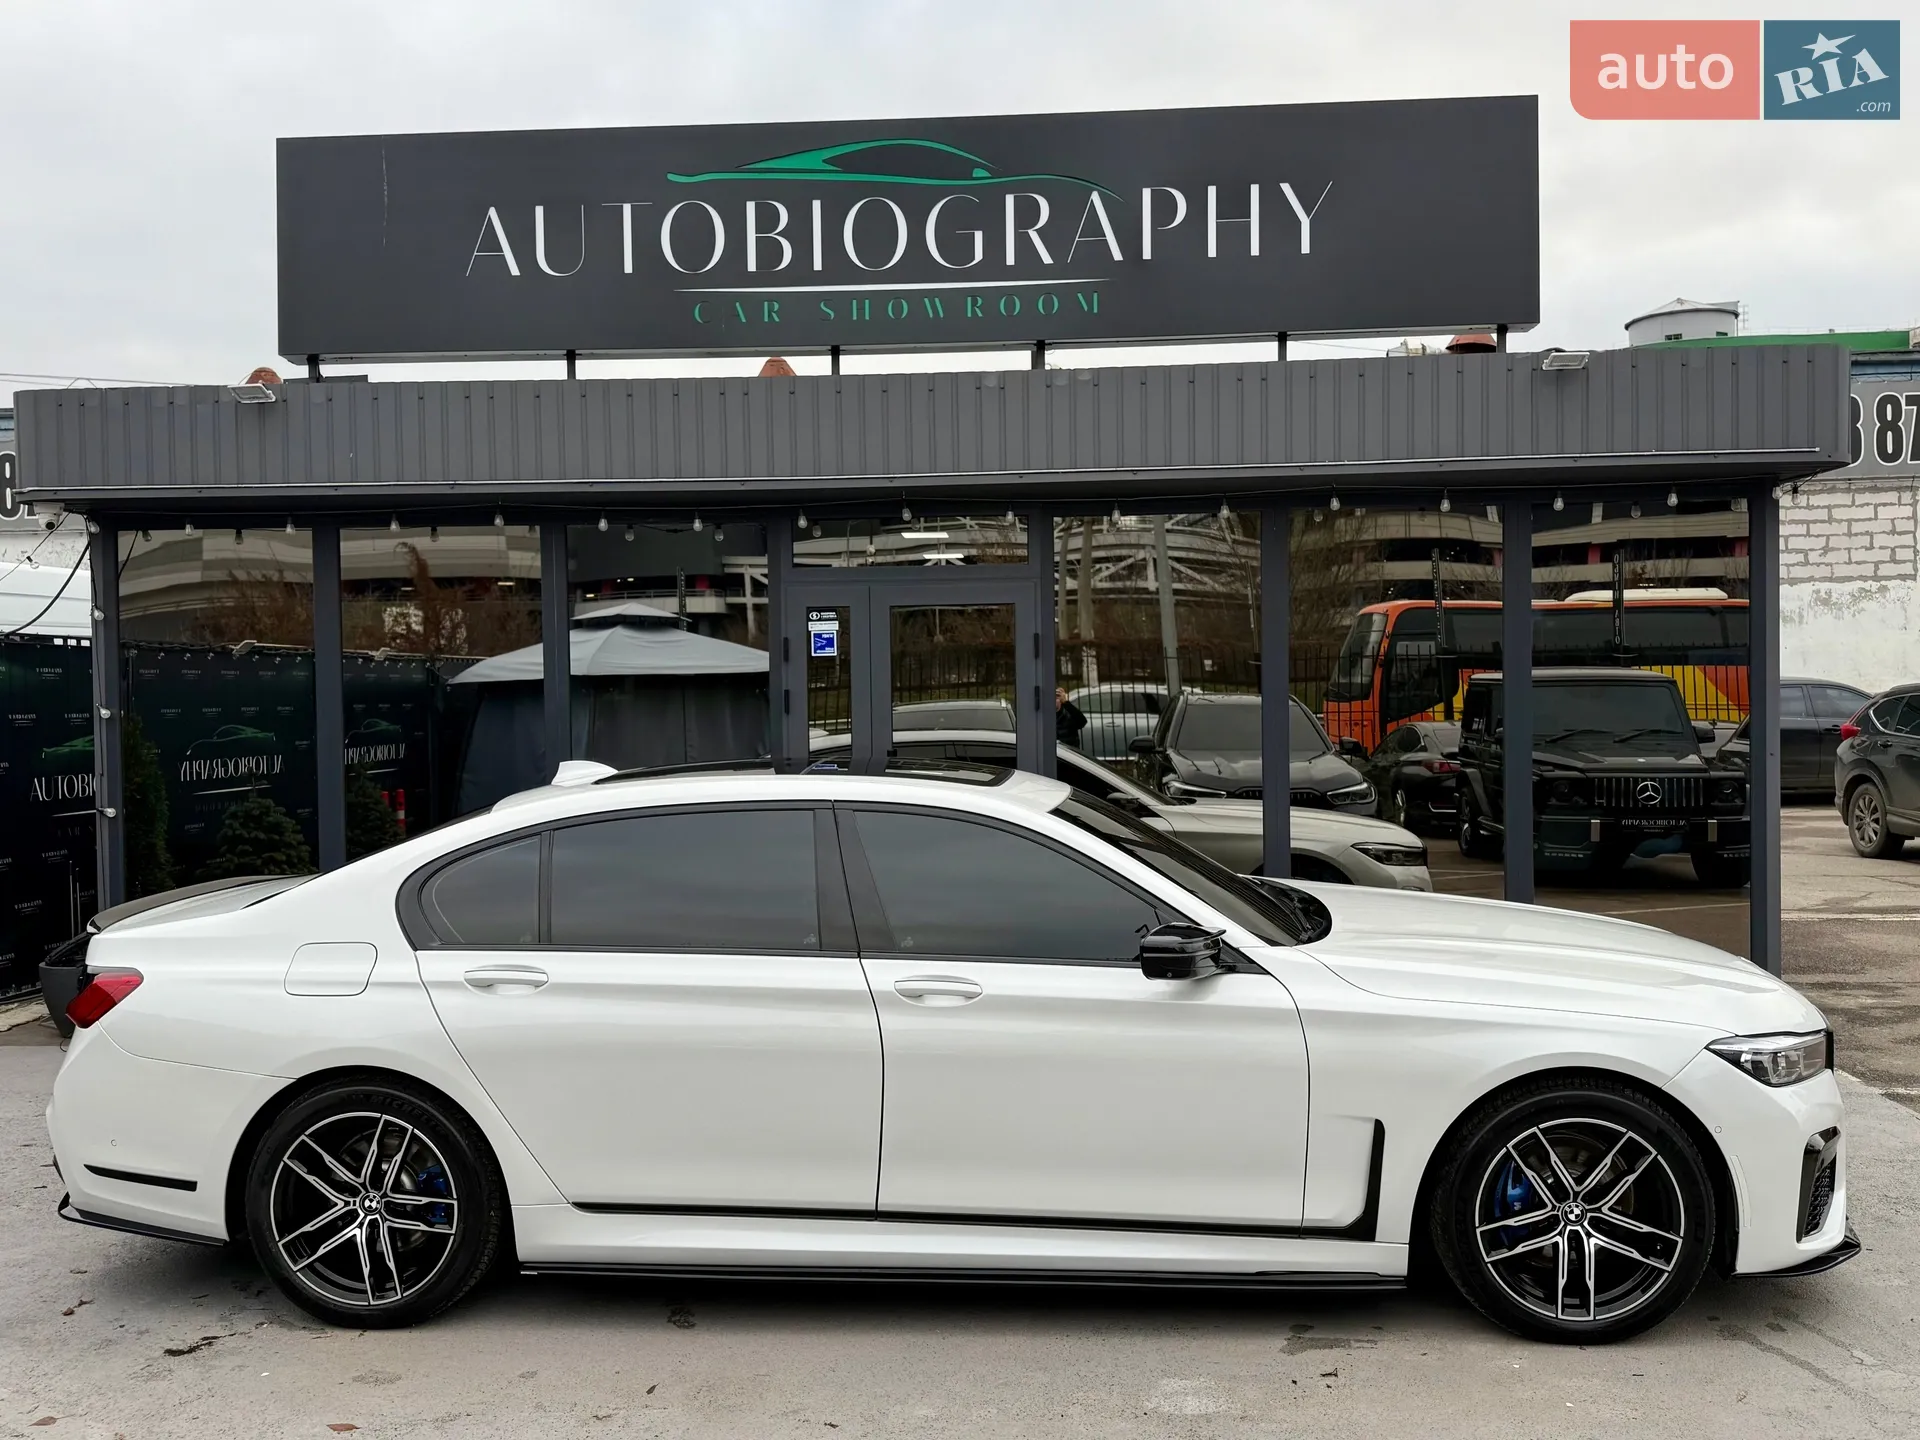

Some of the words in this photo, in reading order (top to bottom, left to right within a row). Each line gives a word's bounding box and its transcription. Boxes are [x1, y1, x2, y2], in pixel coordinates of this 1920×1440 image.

[466, 180, 1334, 277] AUTOBIOGRAPHY
[693, 299, 781, 325] CAR
[819, 290, 1099, 322] SHOWROOM
